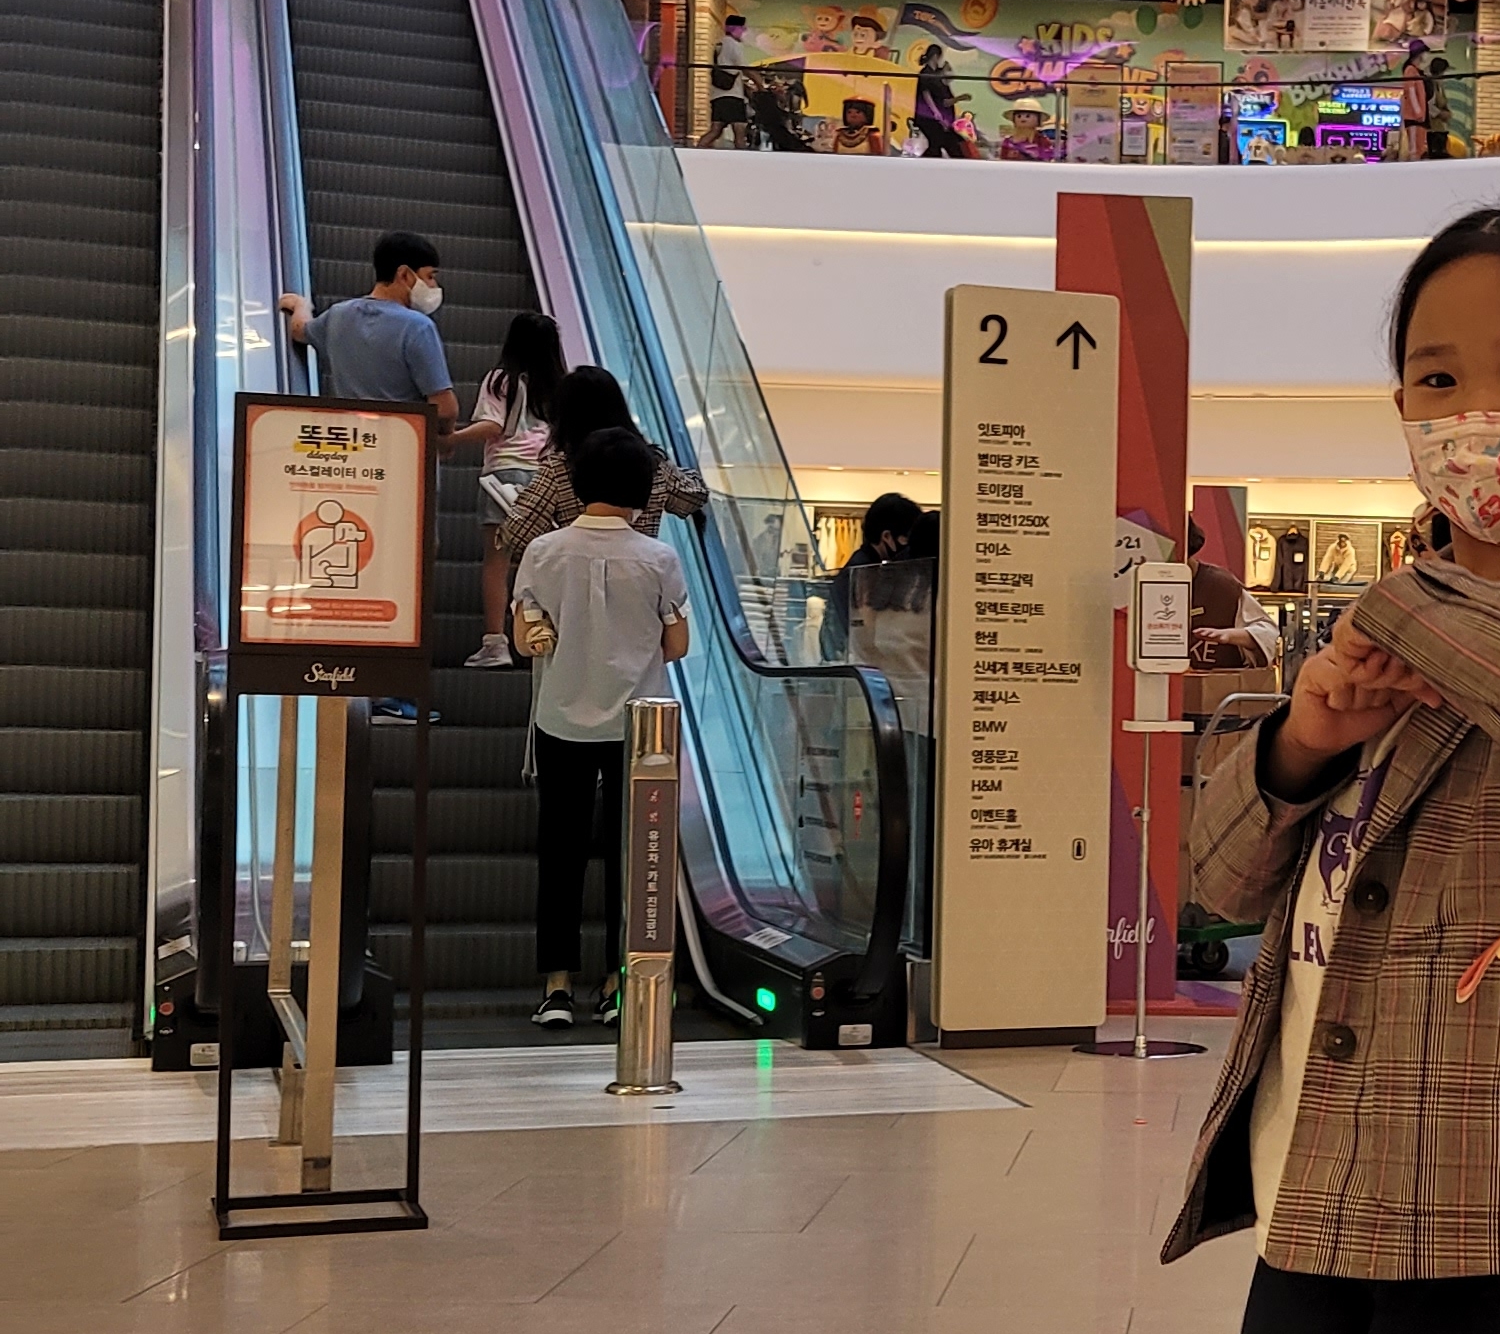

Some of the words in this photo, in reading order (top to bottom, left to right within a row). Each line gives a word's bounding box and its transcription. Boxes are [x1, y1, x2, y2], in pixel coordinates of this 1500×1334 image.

[1037, 23, 1114, 57] KIDS
[979, 314, 1008, 365] 2
[977, 423, 1025, 439] 잇토피아
[362, 432, 378, 448] 한
[977, 453, 1012, 468] 별마당
[1016, 455, 1041, 469] 키즈
[284, 464, 357, 479] 에스컬레이터
[361, 468, 386, 481] 이용
[976, 483, 1024, 498] 토이킹덤
[976, 512, 1050, 528] 챔피언1250X
[975, 542, 1012, 556] 다이소
[975, 601, 1045, 616] 일렉트로마트
[975, 631, 998, 645] 한샘
[974, 661, 1009, 675] 신세계
[1012, 662, 1082, 677] 팩토리스토어
[303, 663, 356, 691] Starfield
[973, 691, 1021, 704] 제네시스
[973, 721, 1007, 733] BMW
[972, 750, 1020, 764] 영풍문고
[971, 780, 1003, 792] H&M
[970, 809, 1018, 823] 이벤트홀
[969, 839, 994, 852] 유아
[997, 839, 1033, 853] 휴게실
